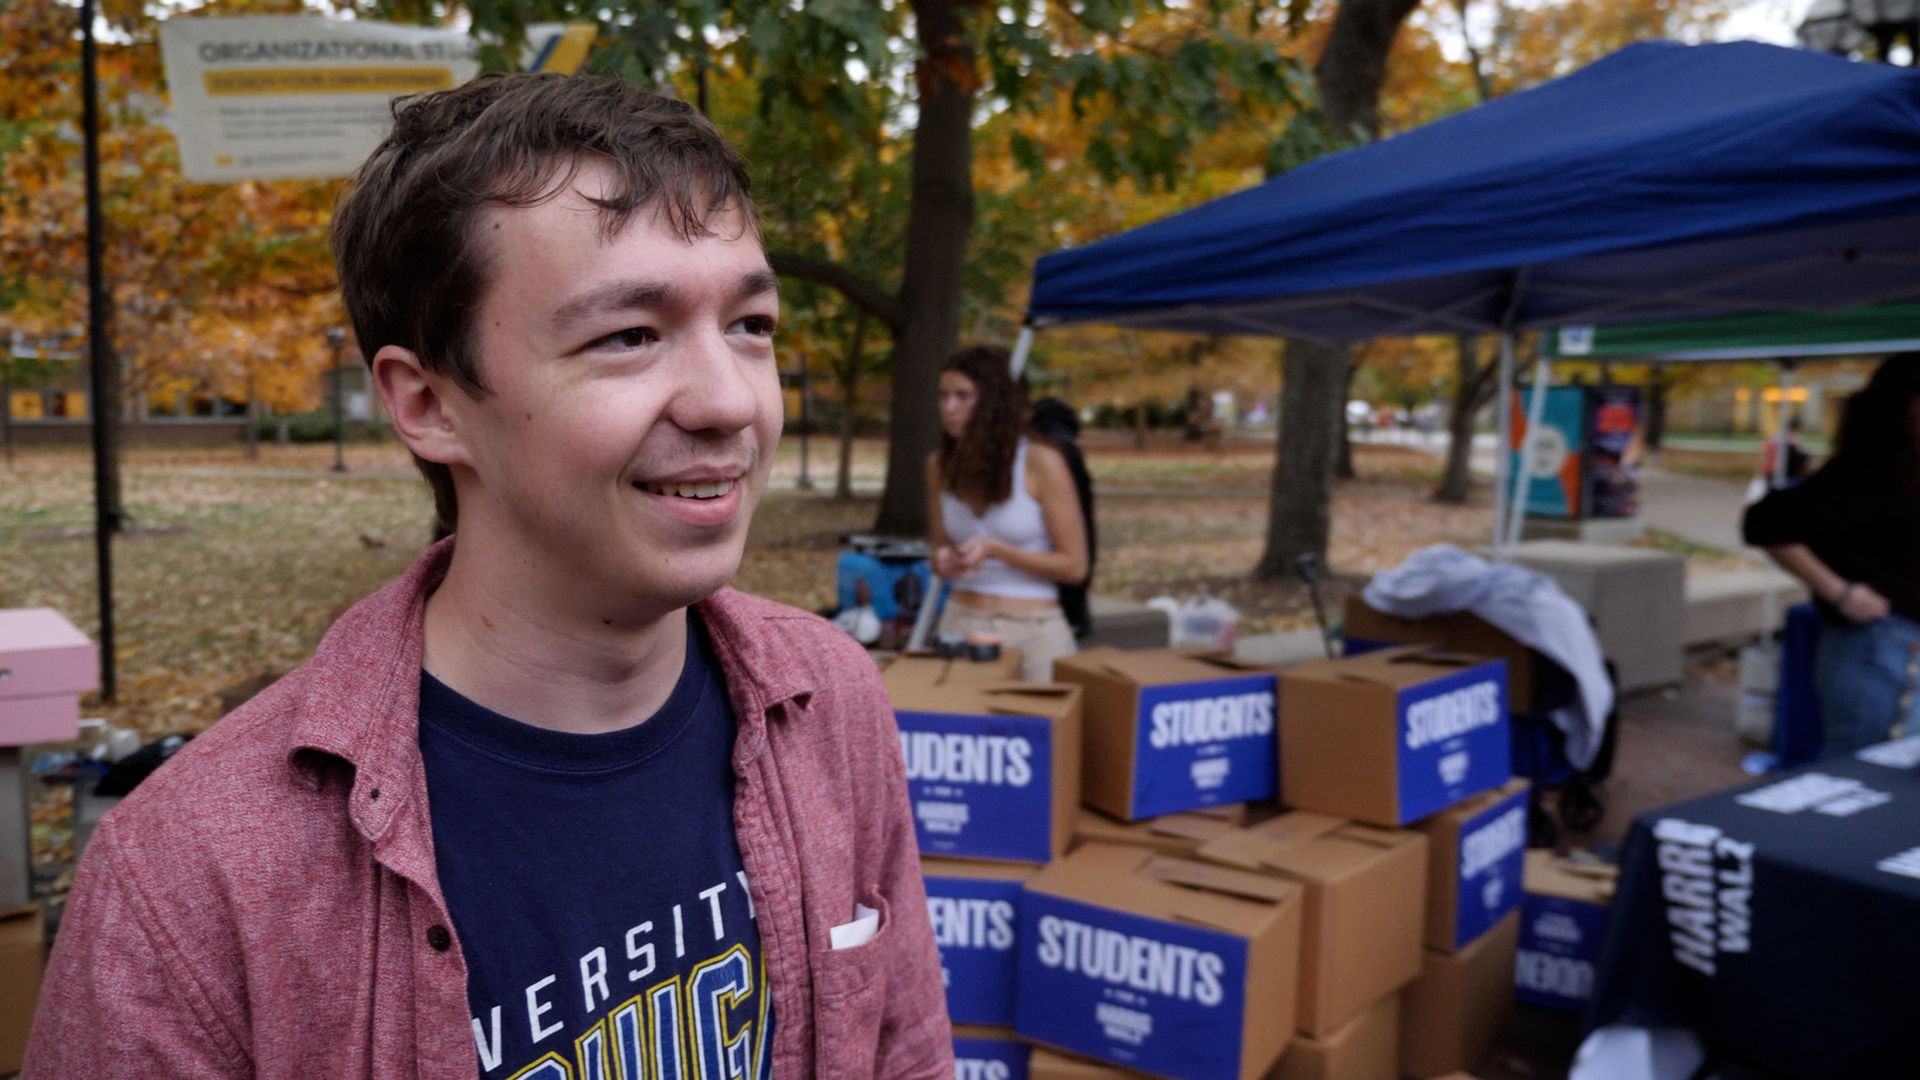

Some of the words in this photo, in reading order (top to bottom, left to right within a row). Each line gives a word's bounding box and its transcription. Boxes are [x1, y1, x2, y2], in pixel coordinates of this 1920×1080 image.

[1150, 691, 1273, 749] STUDENTS
[1404, 680, 1499, 750] STUDENTS
[1037, 915, 1224, 1006] STUDENTS
